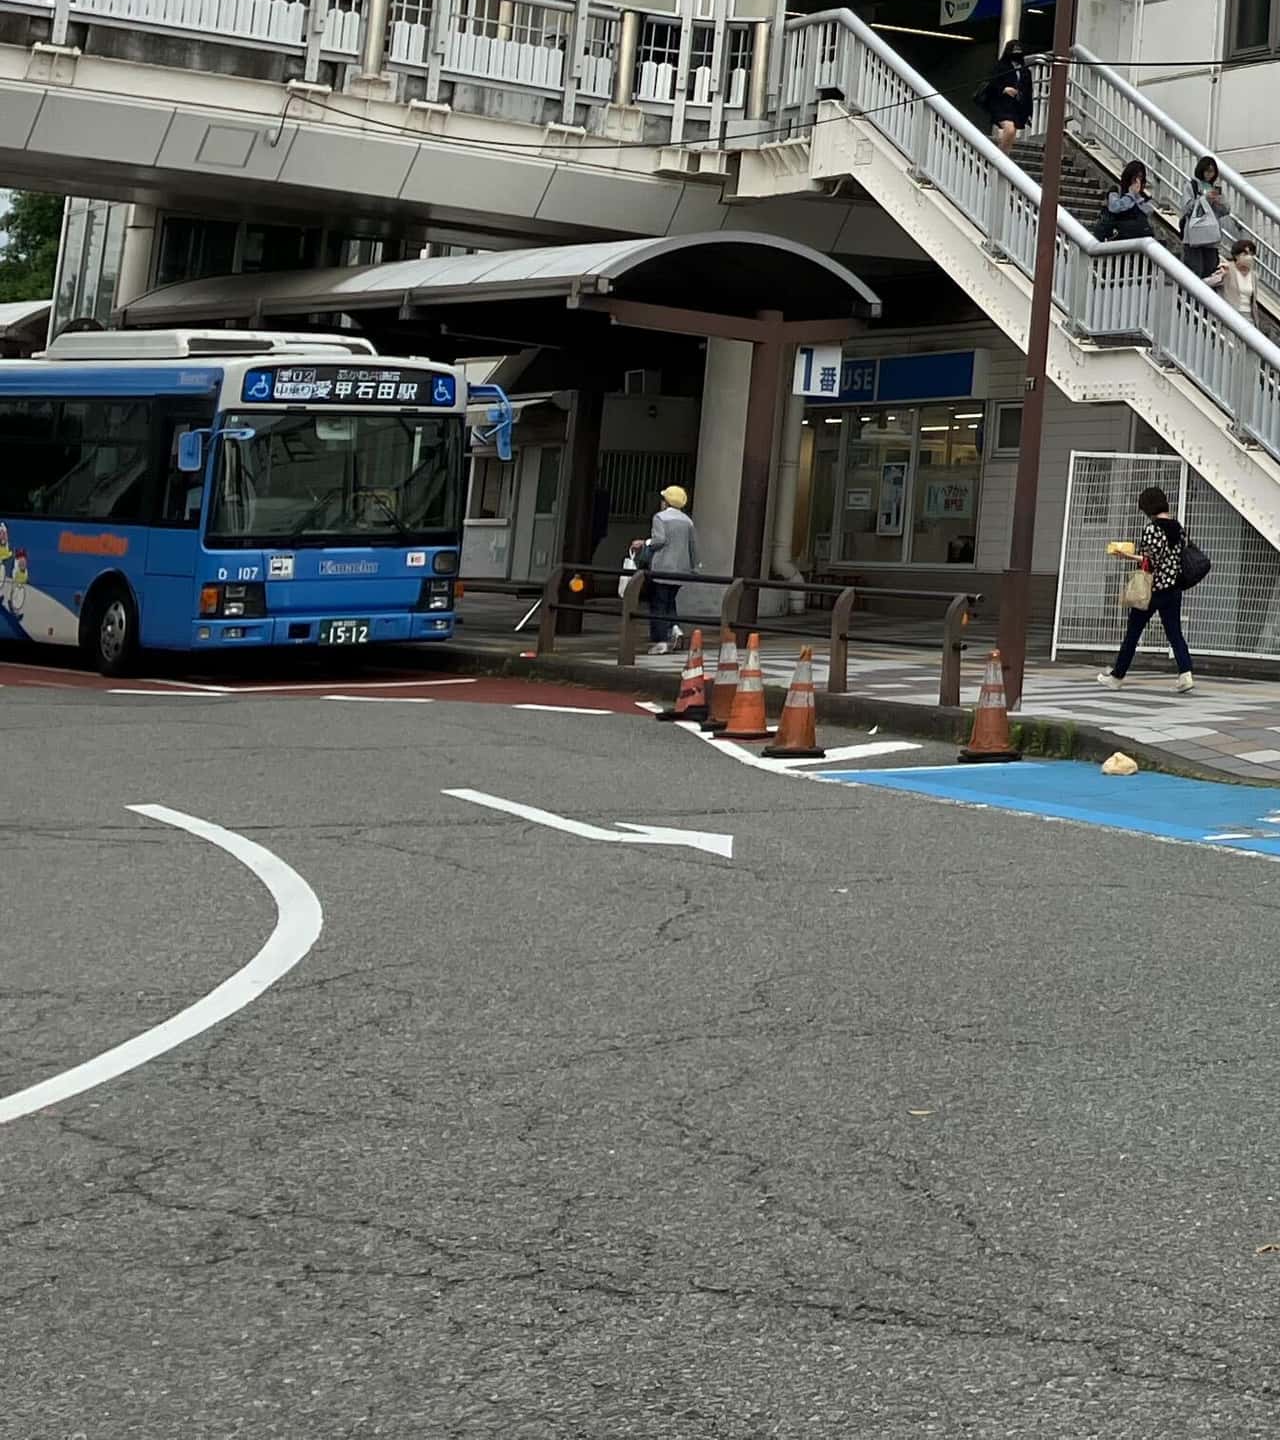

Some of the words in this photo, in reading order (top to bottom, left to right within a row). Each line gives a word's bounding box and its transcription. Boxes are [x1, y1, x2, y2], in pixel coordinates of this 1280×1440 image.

[312, 380, 418, 401] 愛甲石田駅
[238, 566, 259, 580] 107
[328, 625, 369, 643] 15-12
